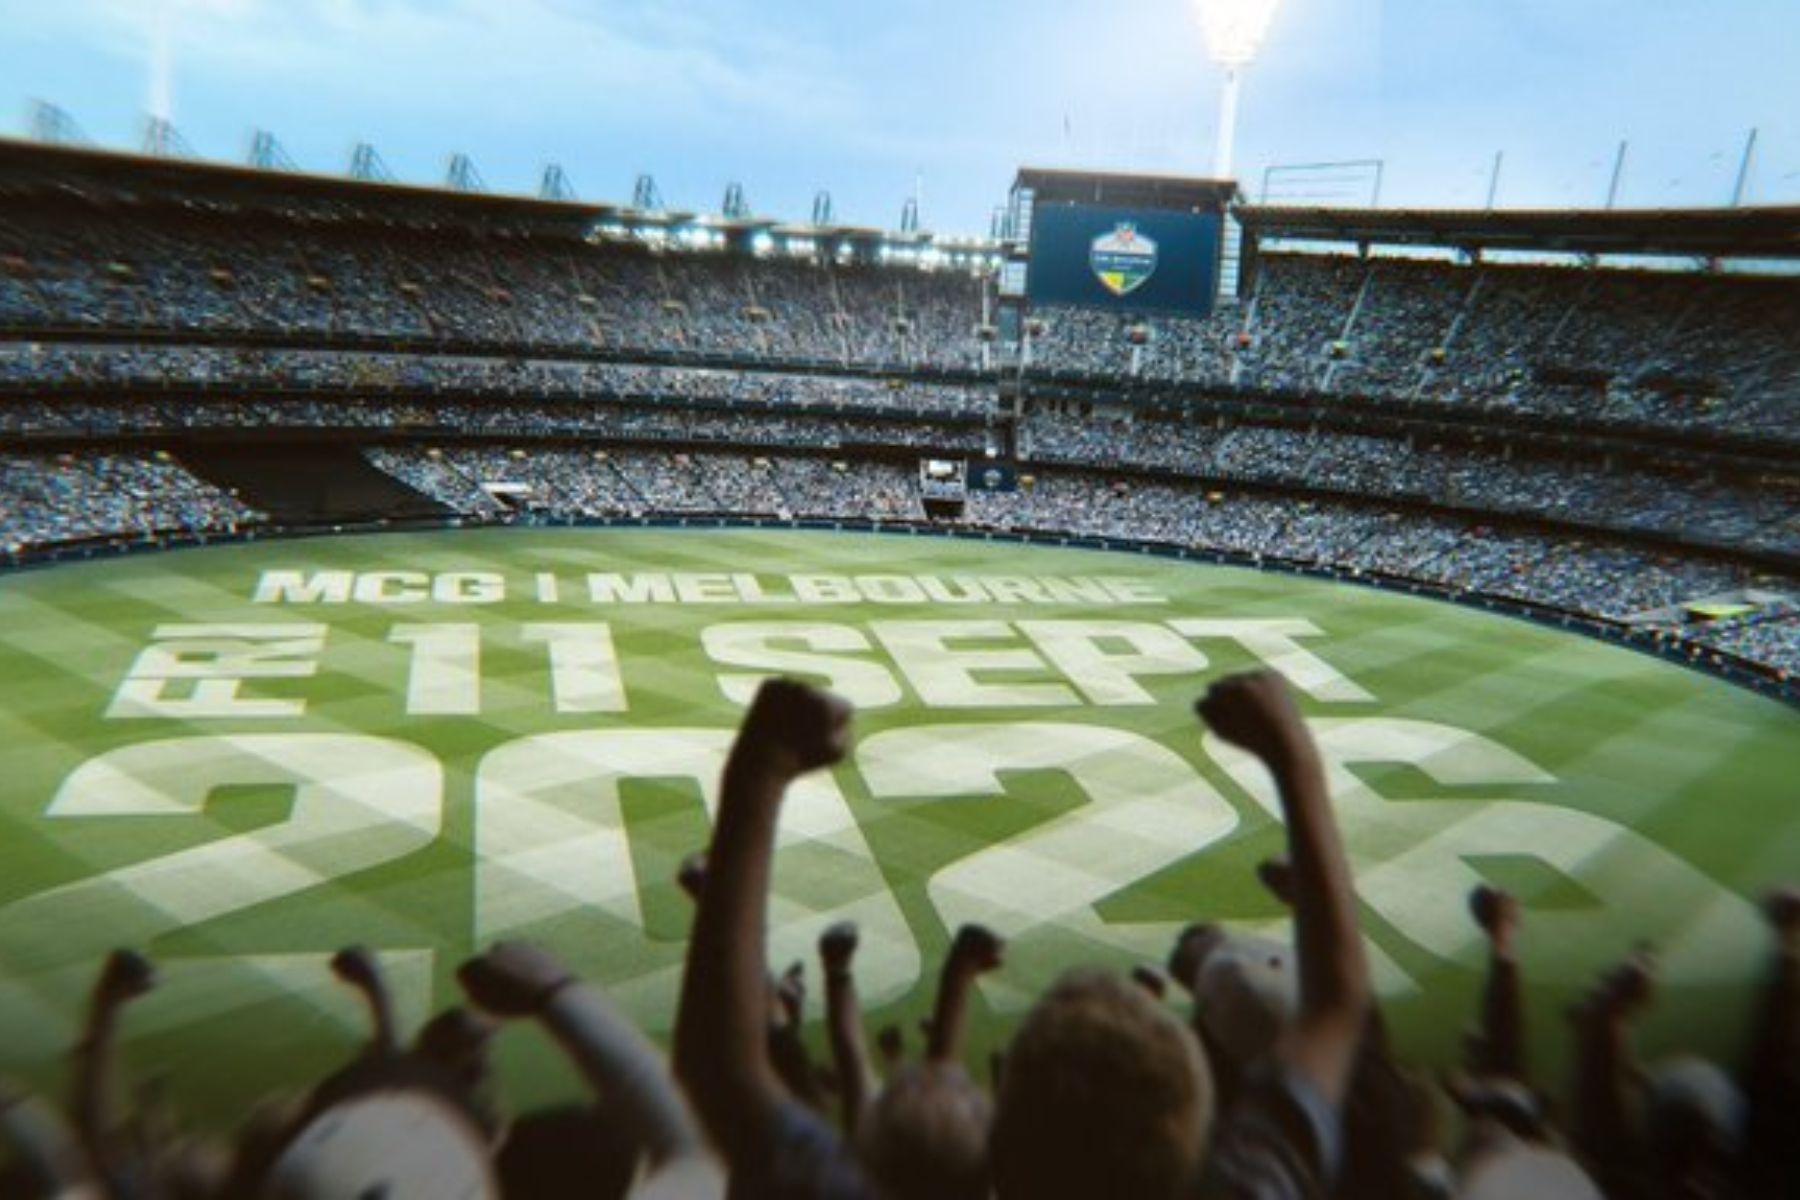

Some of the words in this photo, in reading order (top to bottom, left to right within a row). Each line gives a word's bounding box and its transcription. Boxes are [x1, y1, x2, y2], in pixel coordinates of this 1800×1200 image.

[254, 570, 505, 602] MCG
[587, 573, 1169, 603] MELBOURNE
[105, 623, 329, 718] FRI
[388, 622, 628, 715] 11
[700, 619, 1378, 705] SEPT
[0, 717, 1772, 1040] 2026
